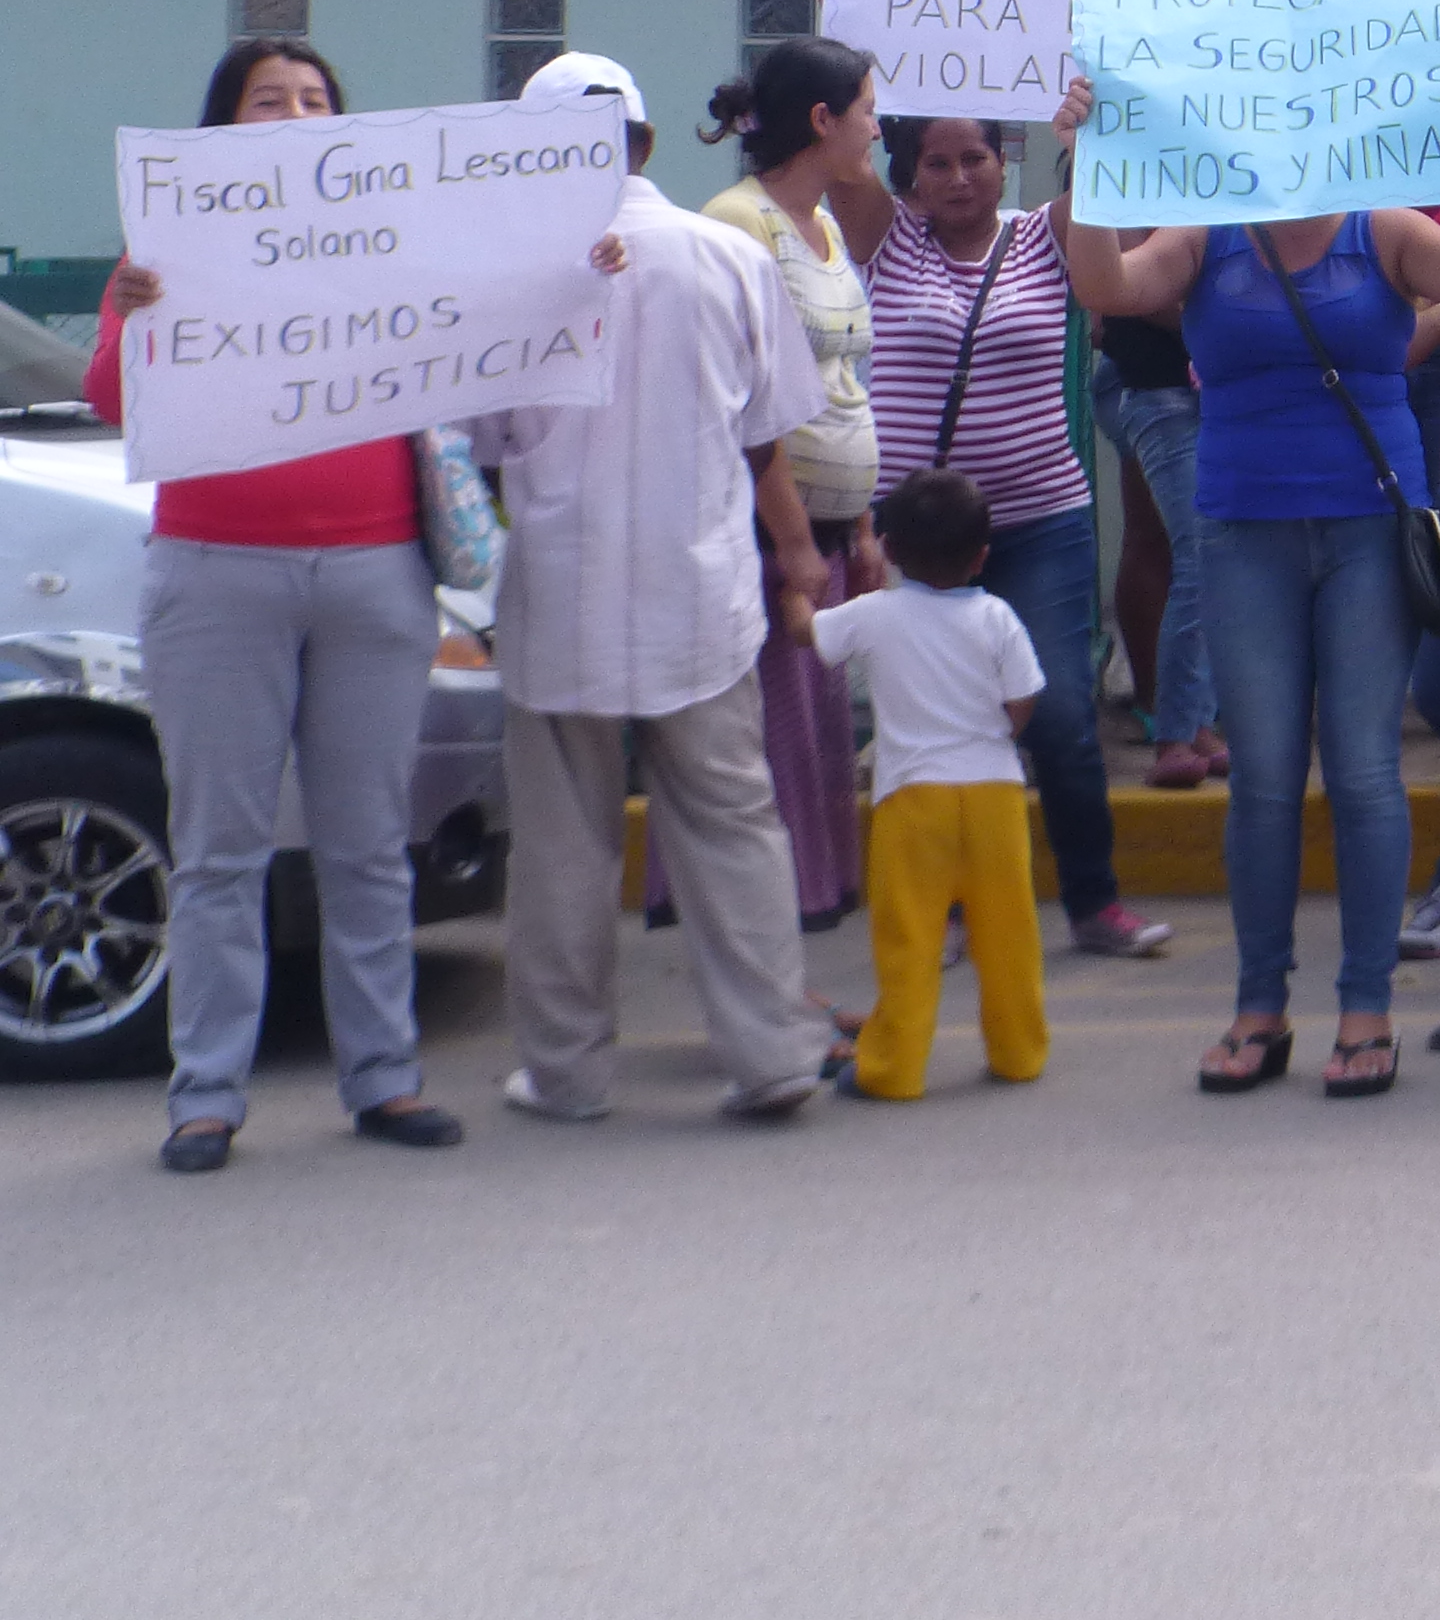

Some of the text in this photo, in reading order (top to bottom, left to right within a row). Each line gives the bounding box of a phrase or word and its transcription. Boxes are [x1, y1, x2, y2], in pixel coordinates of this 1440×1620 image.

[1098, 35, 1162, 72] LA
[1096, 95, 1148, 137] DE
[137, 128, 615, 217] Fiscal Gina Lescano
[1091, 146, 1259, 200] NIÑOS
[251, 225, 398, 266] Solano
[271, 318, 603, 425] JUSTICIA!
